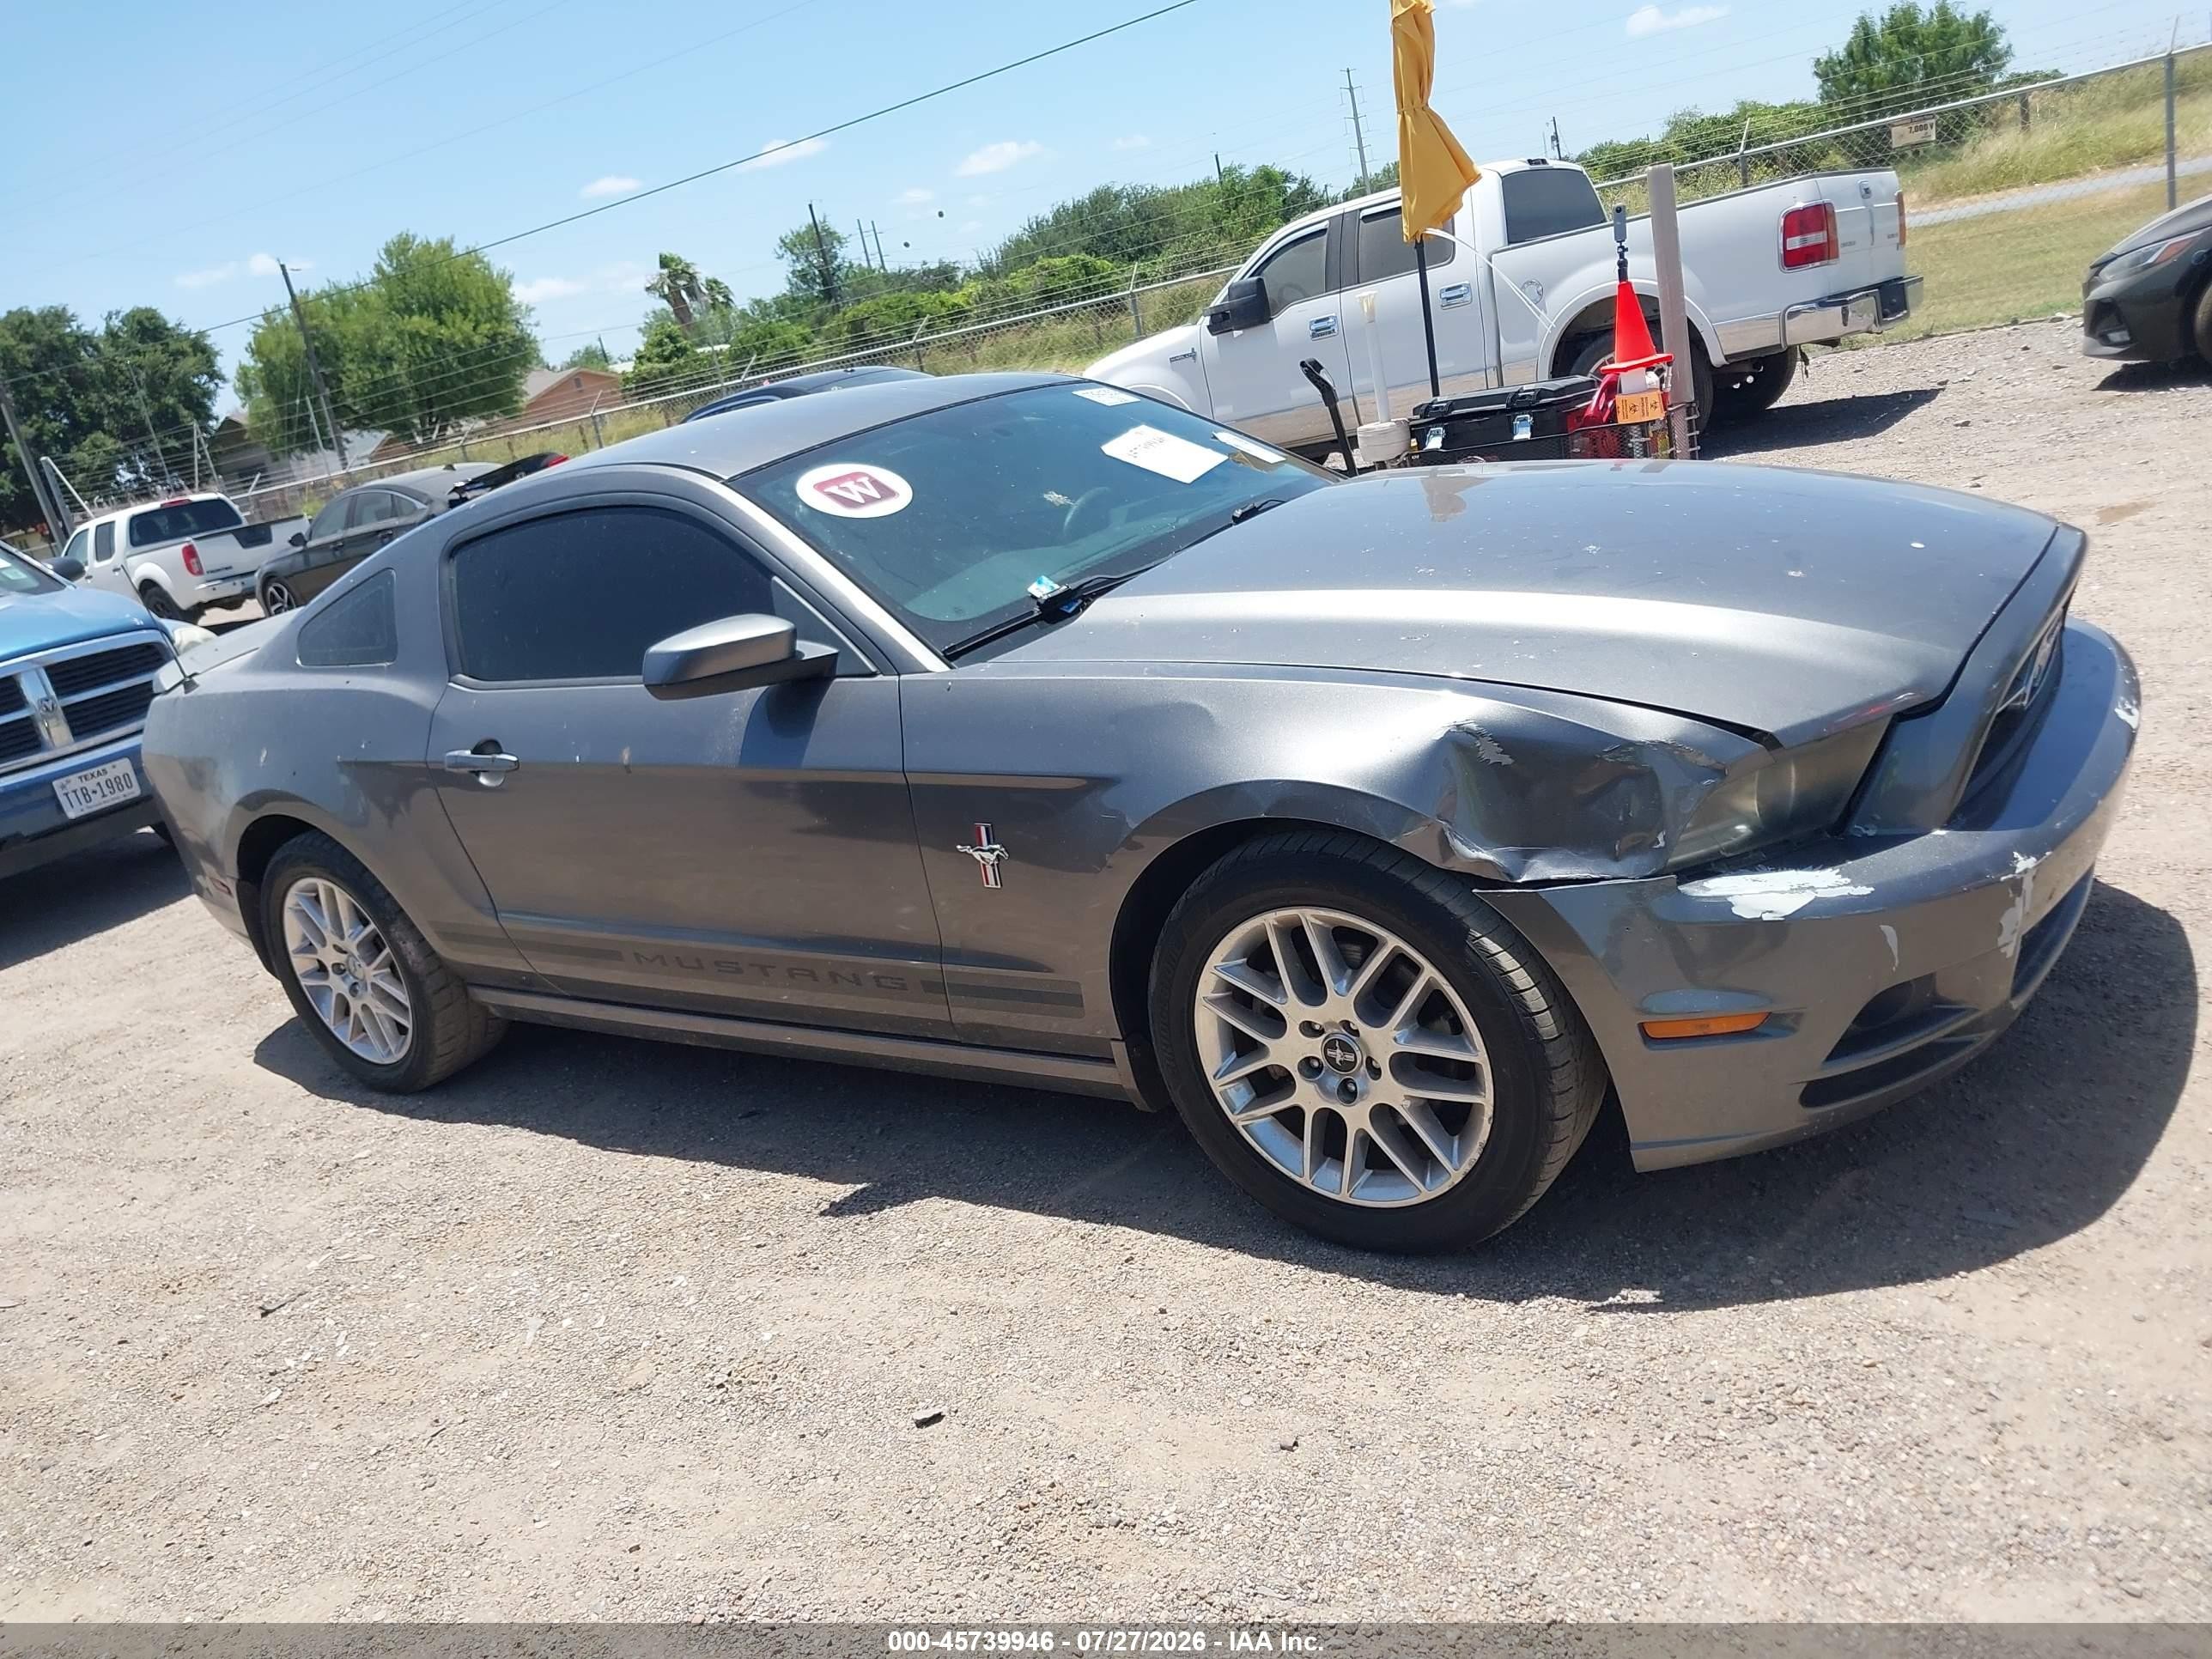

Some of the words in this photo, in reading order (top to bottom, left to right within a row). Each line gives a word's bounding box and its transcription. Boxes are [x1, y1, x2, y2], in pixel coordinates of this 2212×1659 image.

[823, 477, 882, 504] W
[78, 769, 108, 783] TEXAS
[633, 951, 909, 991] MUSTANG
